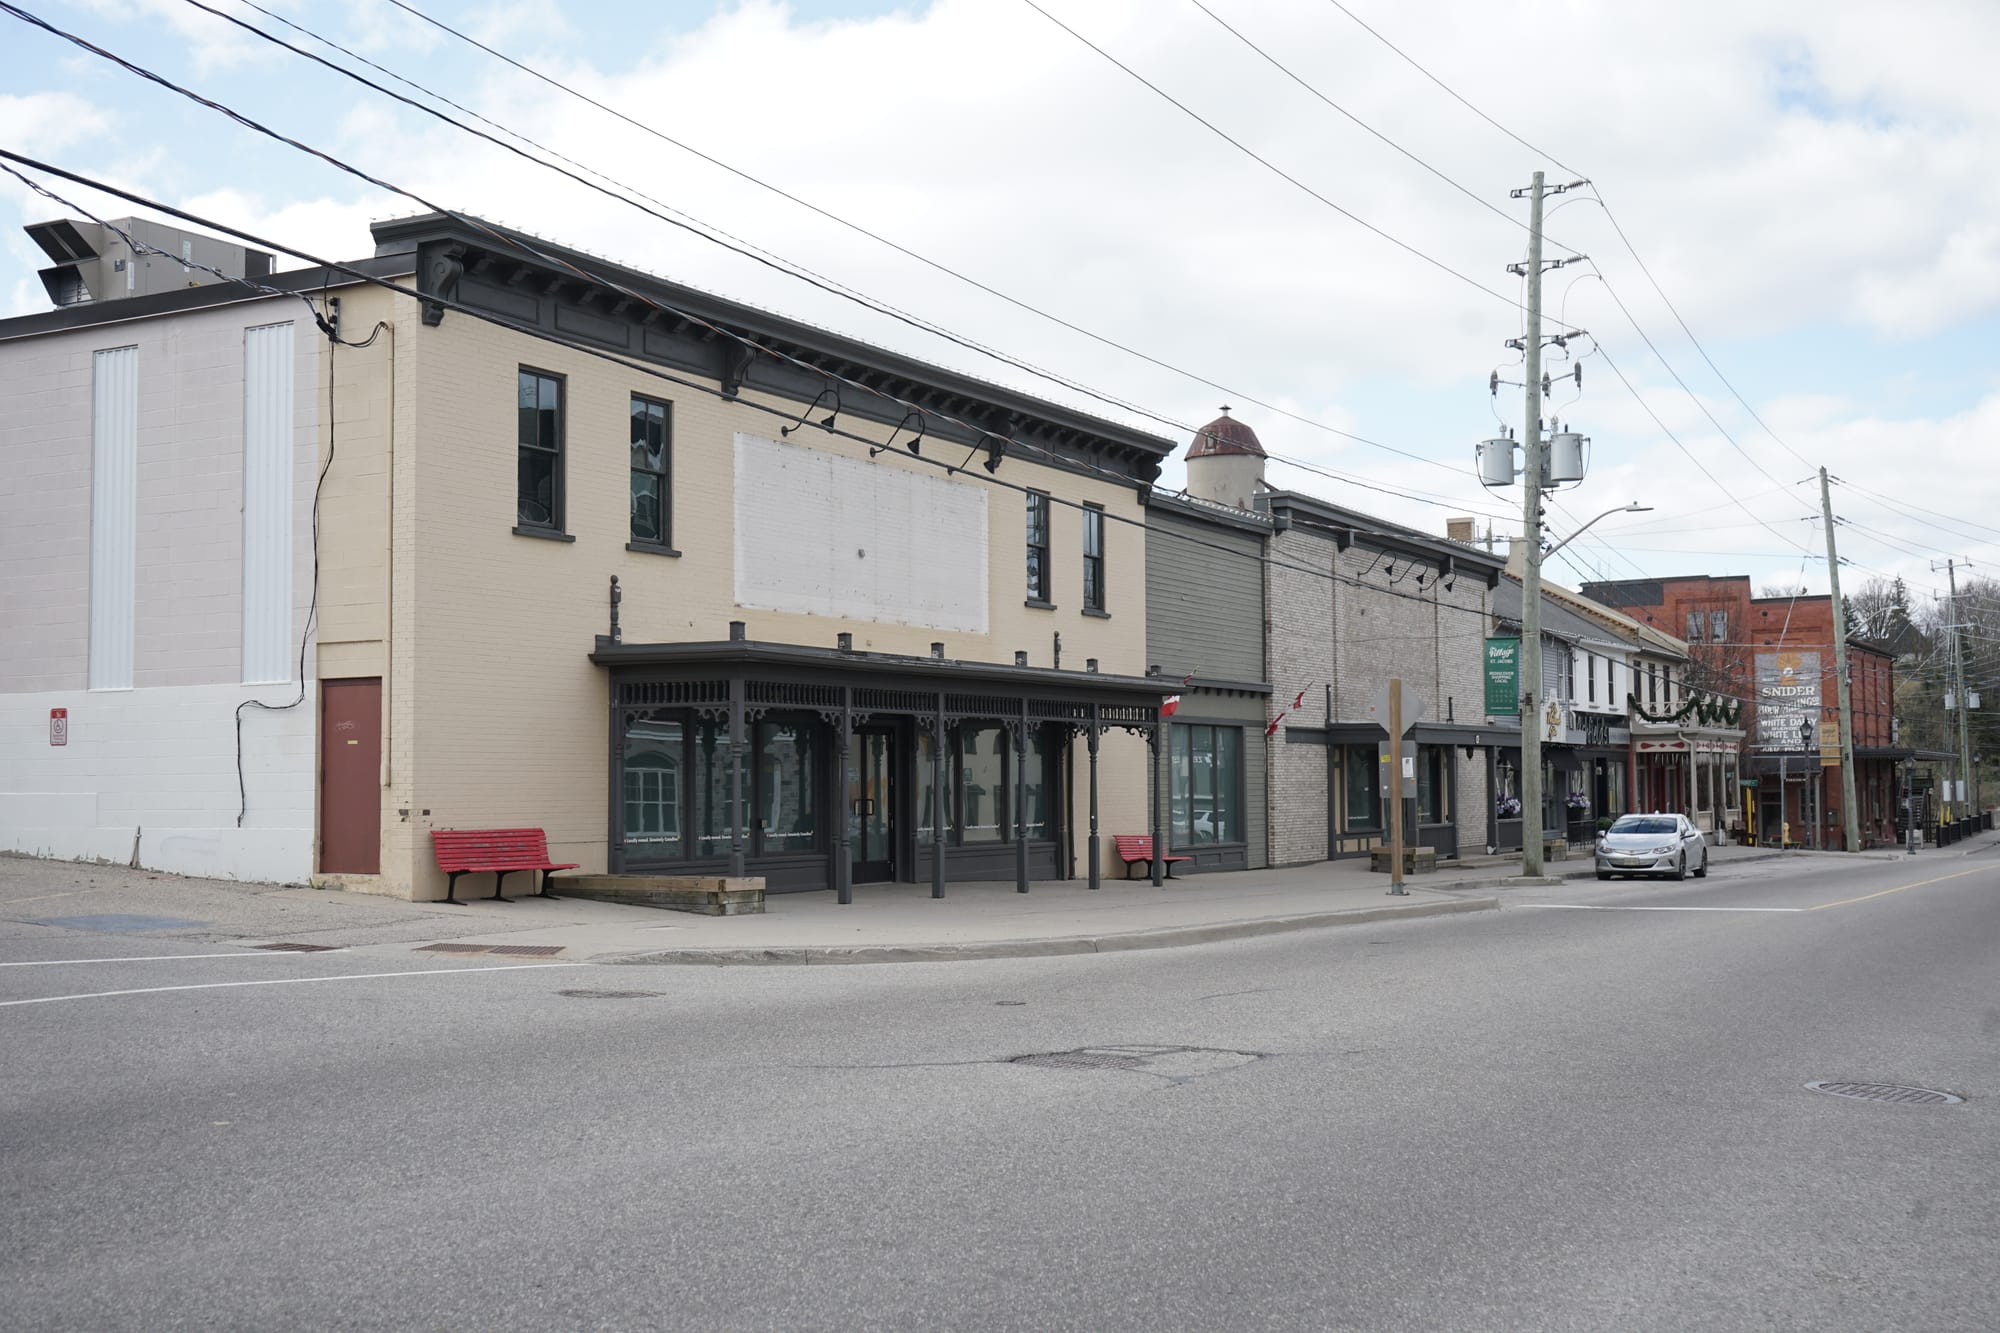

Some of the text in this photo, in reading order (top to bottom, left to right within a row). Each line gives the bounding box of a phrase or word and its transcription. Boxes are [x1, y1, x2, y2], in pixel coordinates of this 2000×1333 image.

[1489, 645, 1514, 658] Village
[1762, 686, 1815, 697] SNIDER
[1760, 718, 1786, 727] WHITE
[1762, 730, 1789, 739] WHITE
